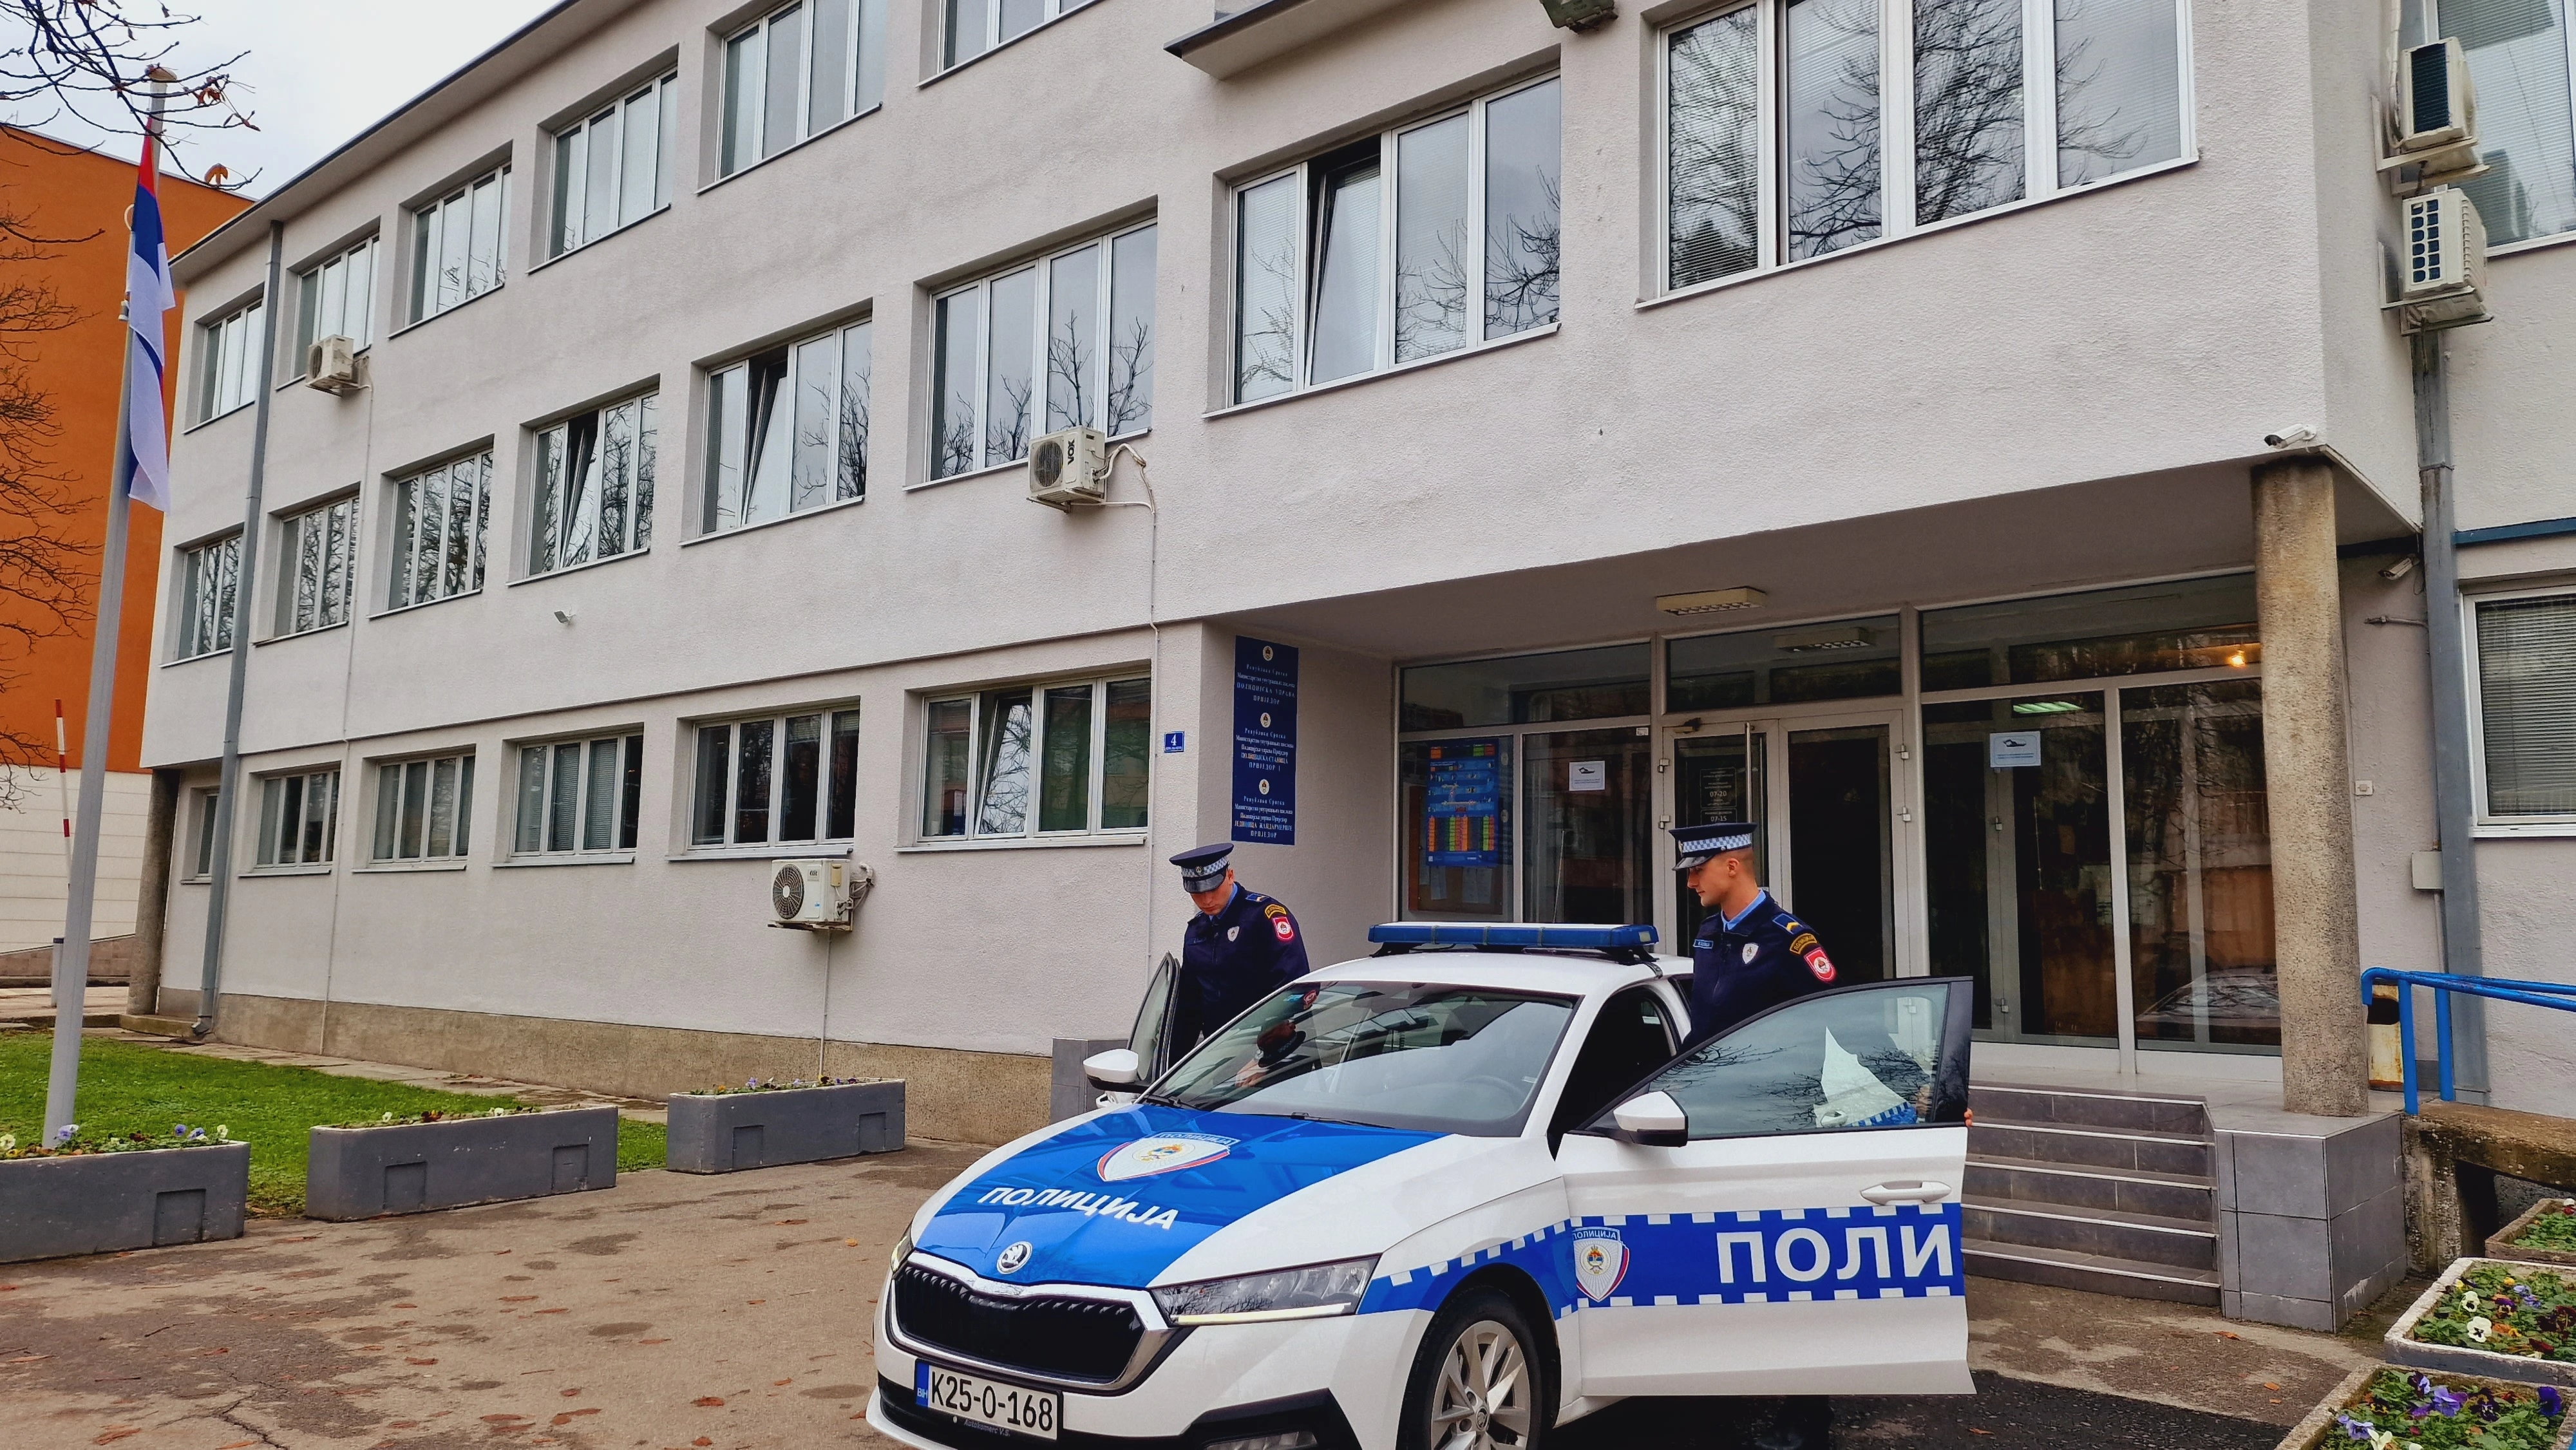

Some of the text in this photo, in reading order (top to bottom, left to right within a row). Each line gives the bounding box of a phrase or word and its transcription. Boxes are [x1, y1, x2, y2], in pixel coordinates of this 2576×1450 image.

[1171, 734, 1177, 746] 4
[1249, 762, 1276, 771] ПРИЈЕДОР
[1159, 1133, 1232, 1144] ПОЛИЦИЈА
[977, 1187, 1179, 1230] ПОЛИЦИЈА
[1716, 1224, 1954, 1284] ПОЛИ
[917, 1388, 928, 1399] BIH
[963, 1419, 998, 1435] Autokomerc
